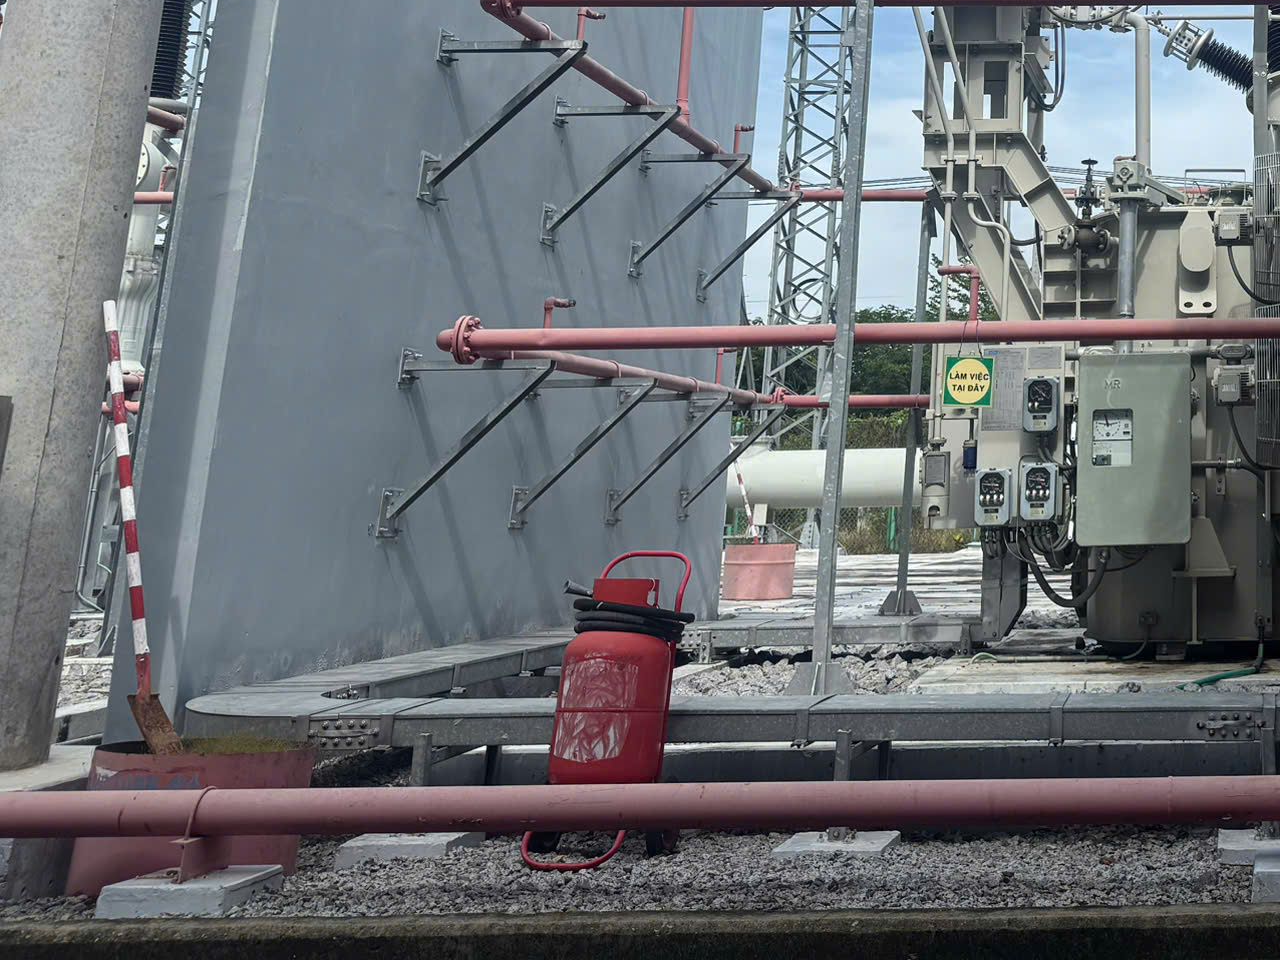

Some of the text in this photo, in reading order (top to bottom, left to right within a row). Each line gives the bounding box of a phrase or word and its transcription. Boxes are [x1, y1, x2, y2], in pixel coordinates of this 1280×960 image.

[950, 371, 989, 381] LÀM VIỆC
[952, 383, 985, 393] TẠI ĐÂY
[1104, 379, 1121, 390] MR
